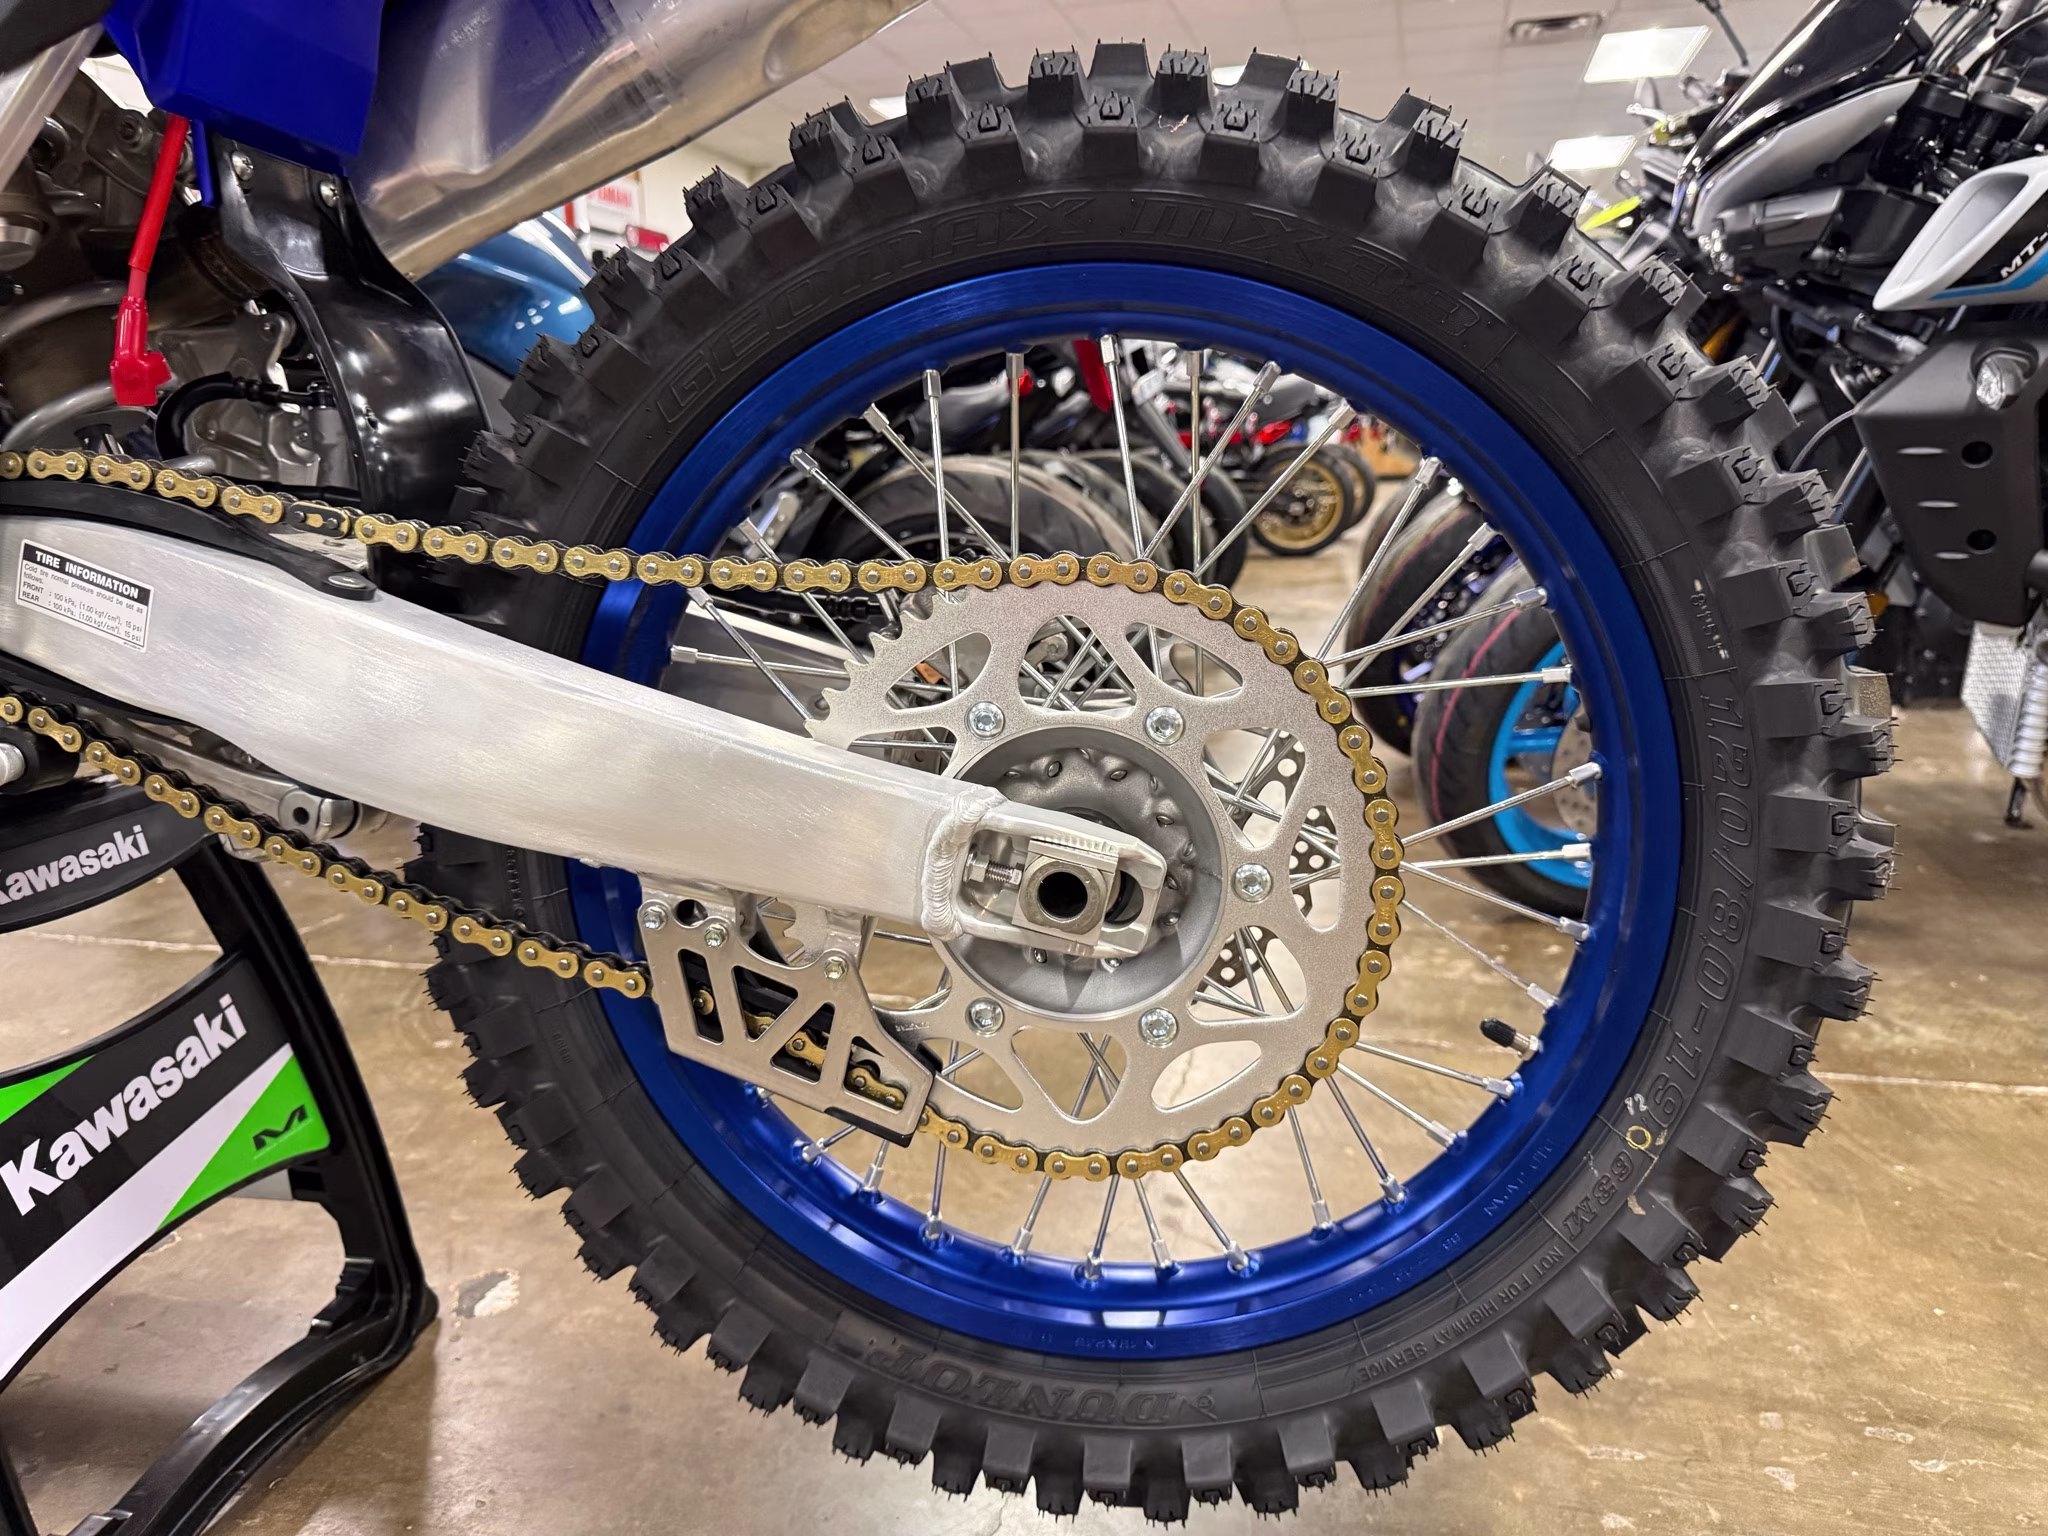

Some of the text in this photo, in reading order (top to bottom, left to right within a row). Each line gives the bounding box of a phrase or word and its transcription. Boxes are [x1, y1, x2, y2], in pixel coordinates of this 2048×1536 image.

[2001, 224, 2048, 279] MT-
[22, 581, 44, 594] FRONT
[53, 592, 64, 602] 100
[125, 620, 132, 629] 15
[132, 624, 142, 633] psi
[24, 563, 38, 573] Cold
[39, 569, 49, 577] tire
[51, 574, 70, 585] normal
[71, 581, 94, 595] pressure
[96, 591, 114, 603] should
[115, 598, 123, 606] be
[125, 602, 134, 610] set
[35, 550, 139, 599] TIRE INFORMATION
[21, 590, 40, 602] REAR
[52, 601, 63, 612] 100
[124, 630, 131, 639] 15
[131, 634, 141, 643] psi
[0, 824, 150, 905] awasaki
[0, 992, 248, 1217] Kawasaki
[1562, 1148, 1635, 1242] 63M
[1357, 1245, 1565, 1382] NOT FOR HIGHWAY SERVICE
[863, 1344, 1180, 1427] DUNLOP
